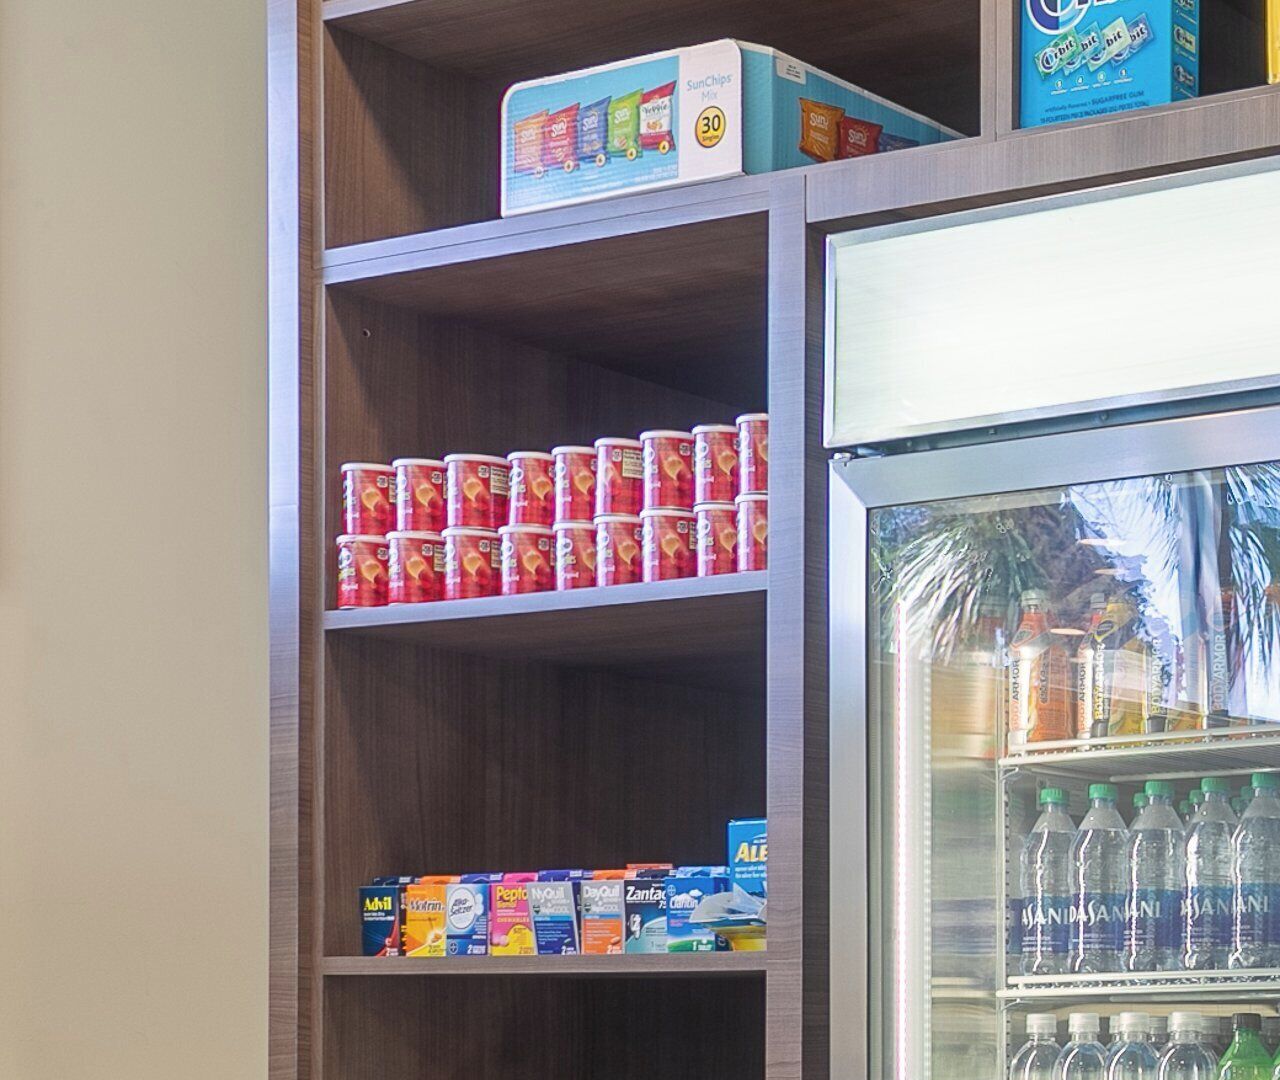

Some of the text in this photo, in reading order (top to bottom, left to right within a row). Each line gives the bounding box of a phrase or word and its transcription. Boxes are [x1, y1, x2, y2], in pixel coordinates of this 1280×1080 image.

[1040, 37, 1075, 72] Orbit
[687, 74, 733, 91] SunChips
[702, 114, 721, 134] 30
[531, 887, 565, 901] NyQuil
[583, 885, 620, 900] DayQuil
[364, 897, 392, 911] Advil
